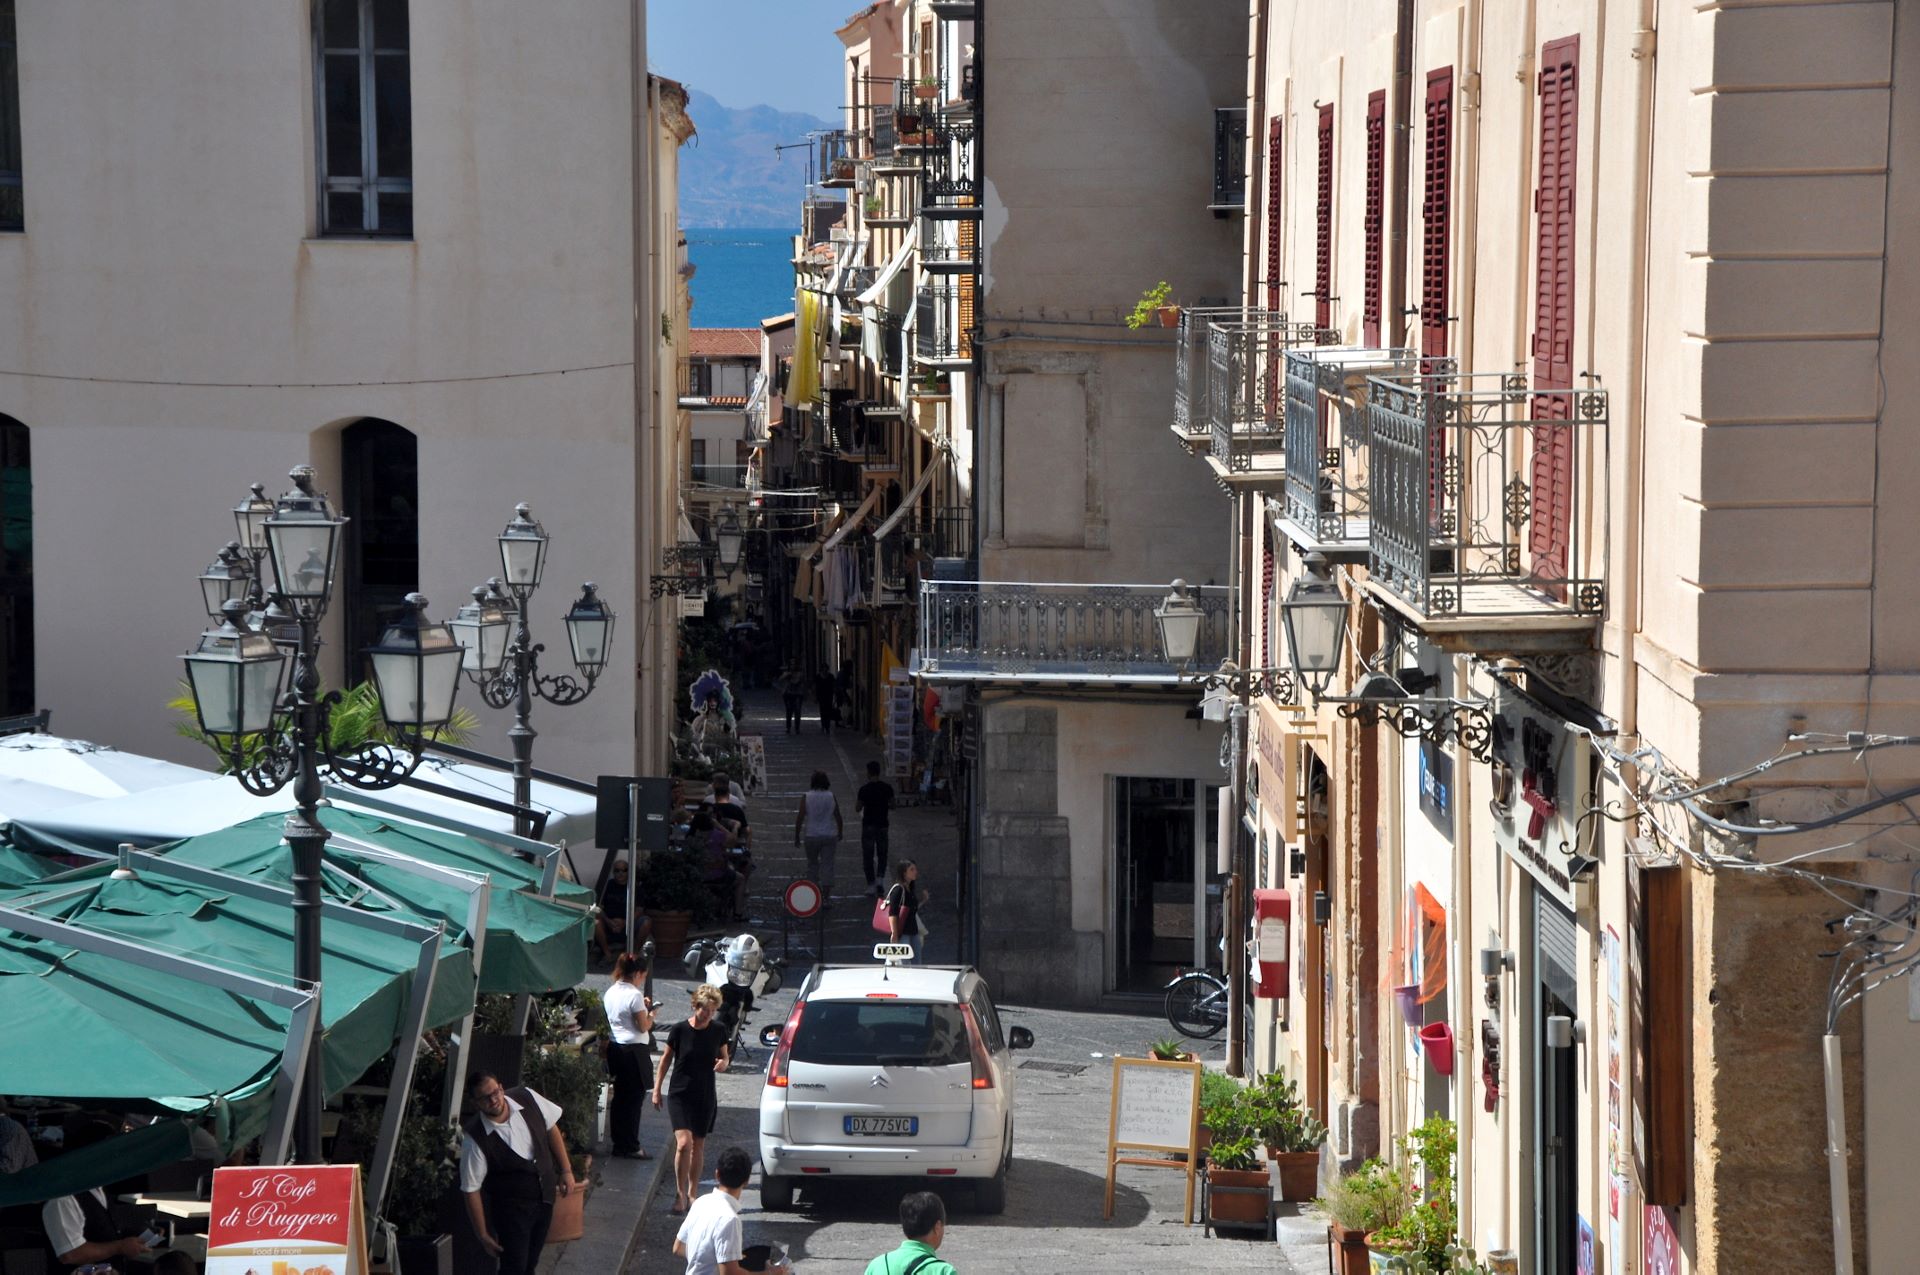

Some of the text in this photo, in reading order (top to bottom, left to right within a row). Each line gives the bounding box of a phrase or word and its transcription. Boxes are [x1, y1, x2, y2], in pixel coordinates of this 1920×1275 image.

[879, 946, 907, 955] TAXI
[853, 1119, 909, 1131] DX 775VC
[239, 1176, 270, 1198] Il
[219, 1200, 338, 1237] di Ruggero
[252, 1247, 273, 1256] Food
[282, 1247, 302, 1256] more
